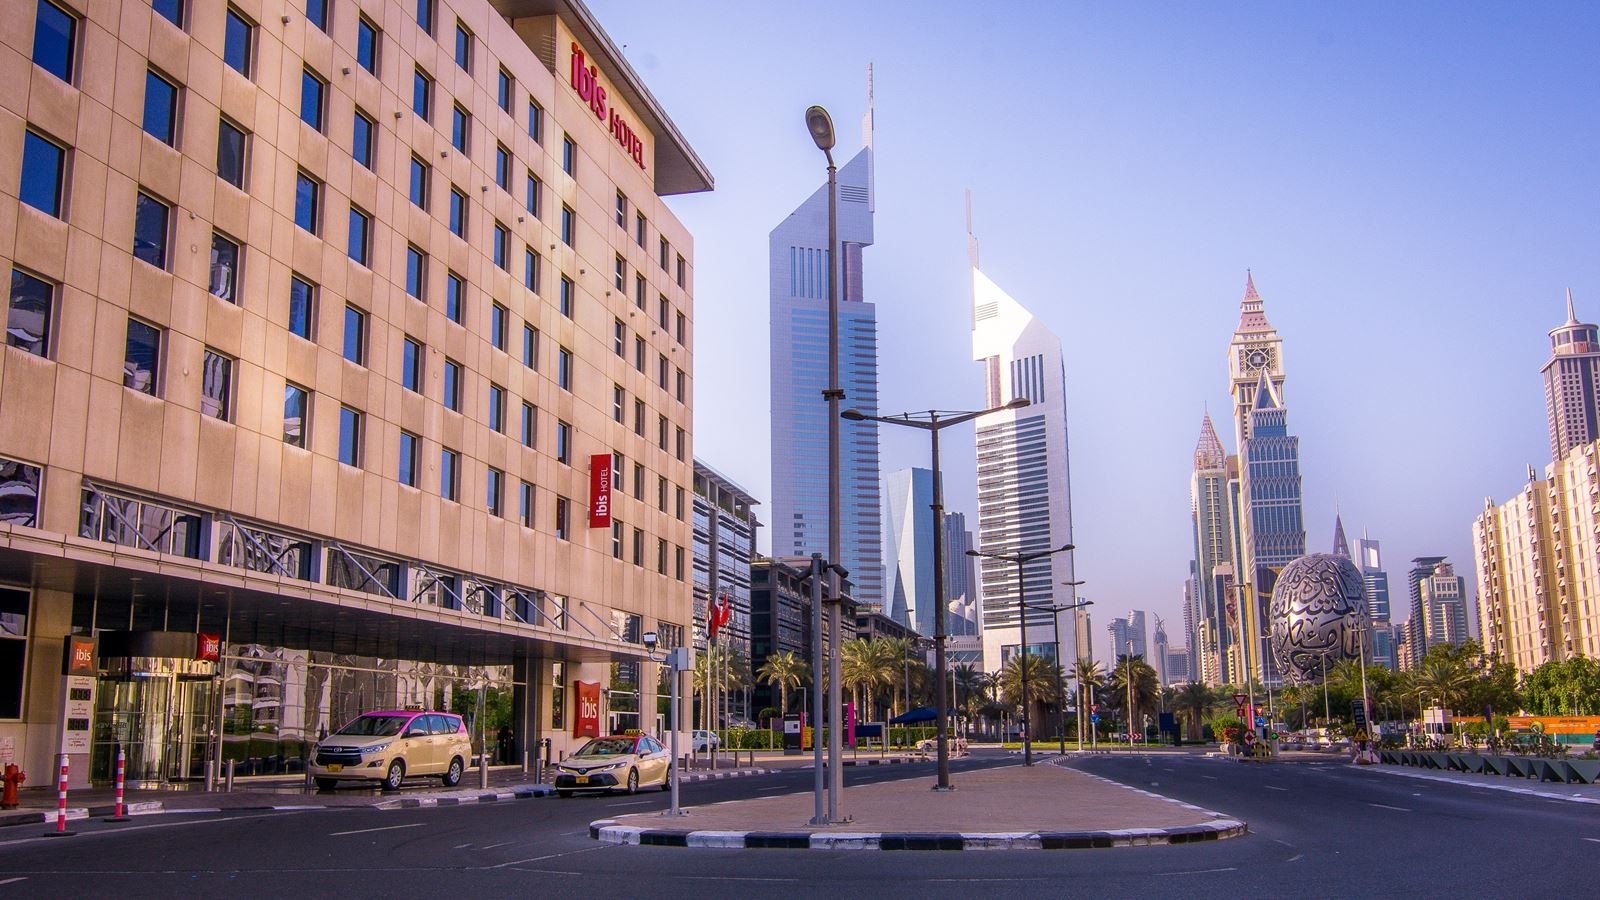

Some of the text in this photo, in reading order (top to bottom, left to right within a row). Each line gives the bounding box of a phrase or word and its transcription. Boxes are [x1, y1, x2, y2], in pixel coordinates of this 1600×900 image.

[571, 42, 646, 169] ibis HOTEL
[596, 495, 607, 516] ibis
[76, 648, 92, 662] ibis
[206, 640, 219, 653] ibis
[582, 696, 597, 719] ibis
